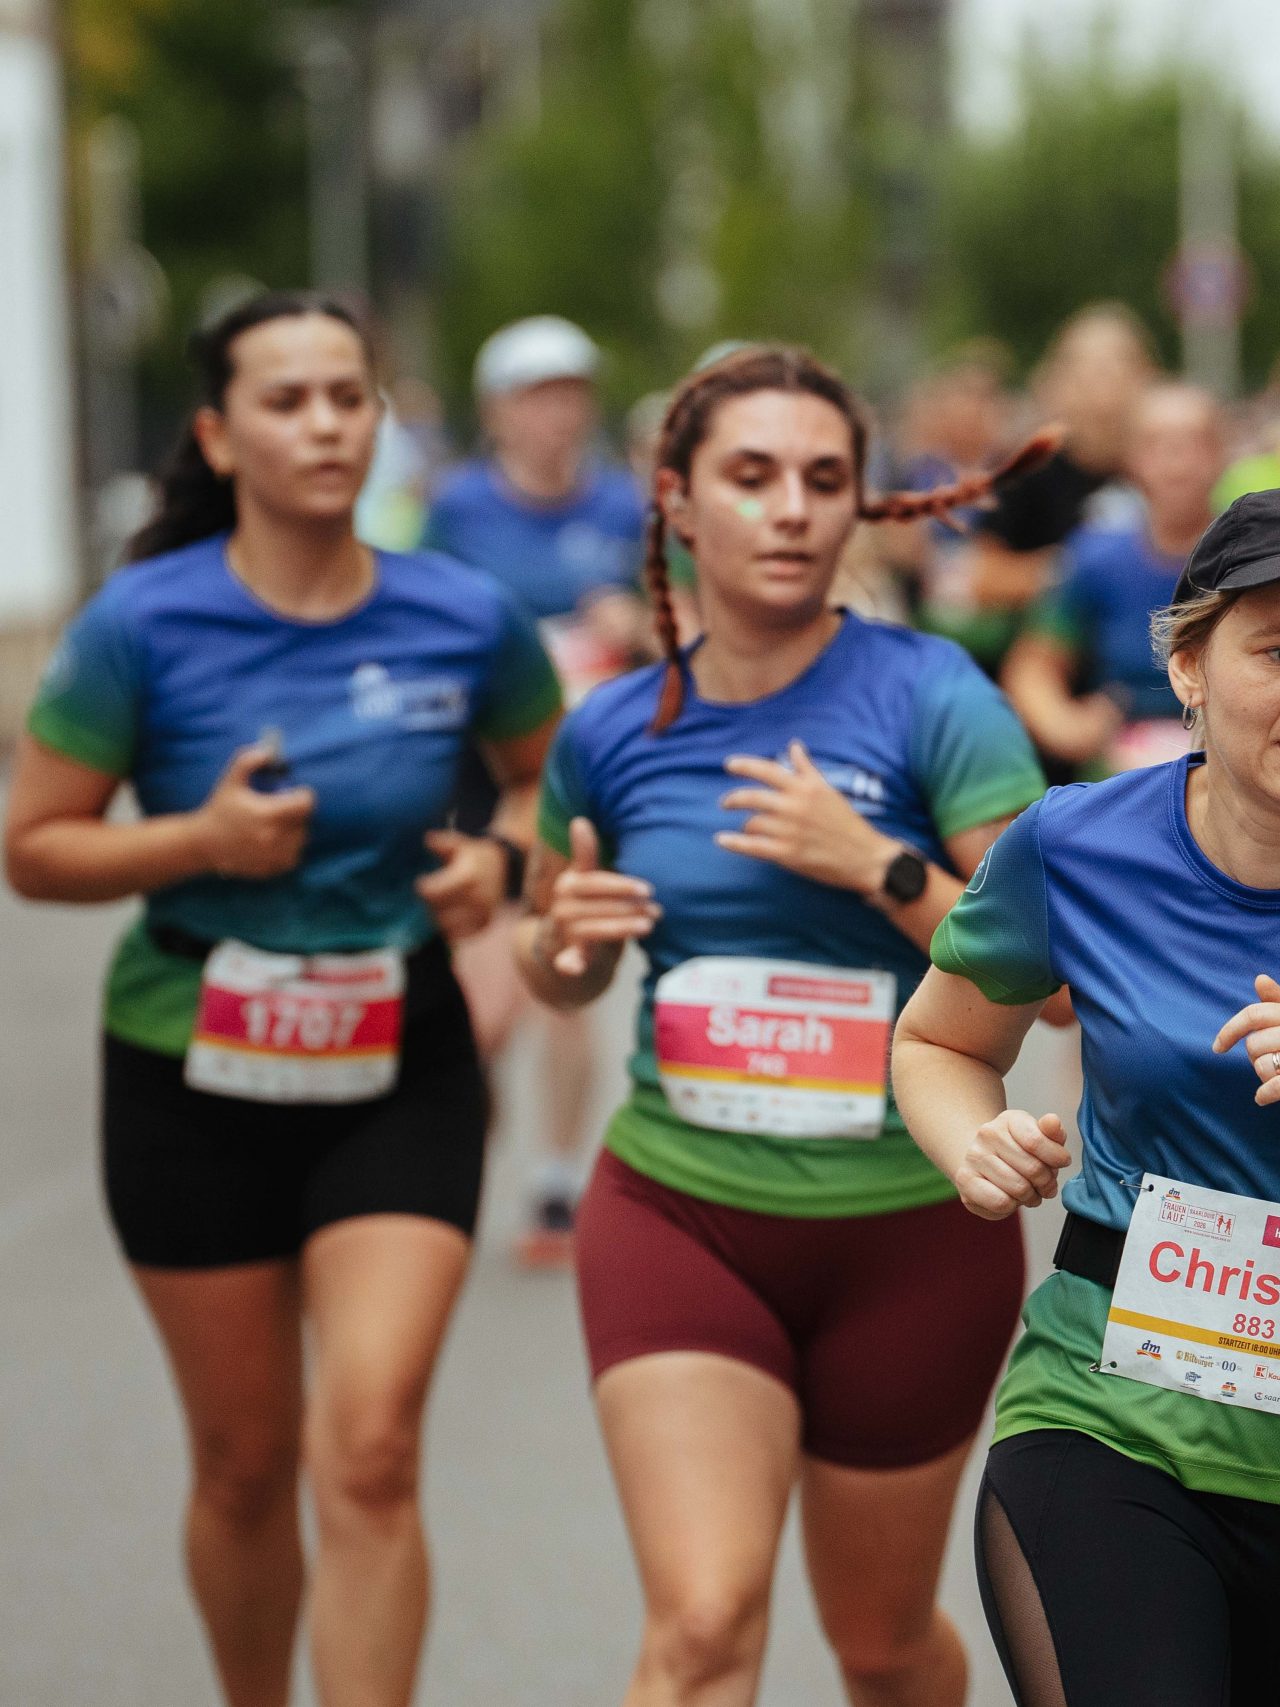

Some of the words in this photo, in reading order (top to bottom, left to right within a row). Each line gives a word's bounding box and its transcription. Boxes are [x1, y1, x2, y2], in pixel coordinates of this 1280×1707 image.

[706, 1002, 834, 1055] Sarah
[1168, 1187, 1181, 1197] dm
[1163, 1201, 1187, 1214] FRAUEN
[1161, 1210, 1186, 1224] LAUF
[1232, 1313, 1276, 1340] 883
[1141, 1340, 1161, 1354] dm
[1218, 1336, 1252, 1350] STARTZEIT
[1251, 1343, 1269, 1354] 18:00
[1183, 1351, 1214, 1368] Bitburger
